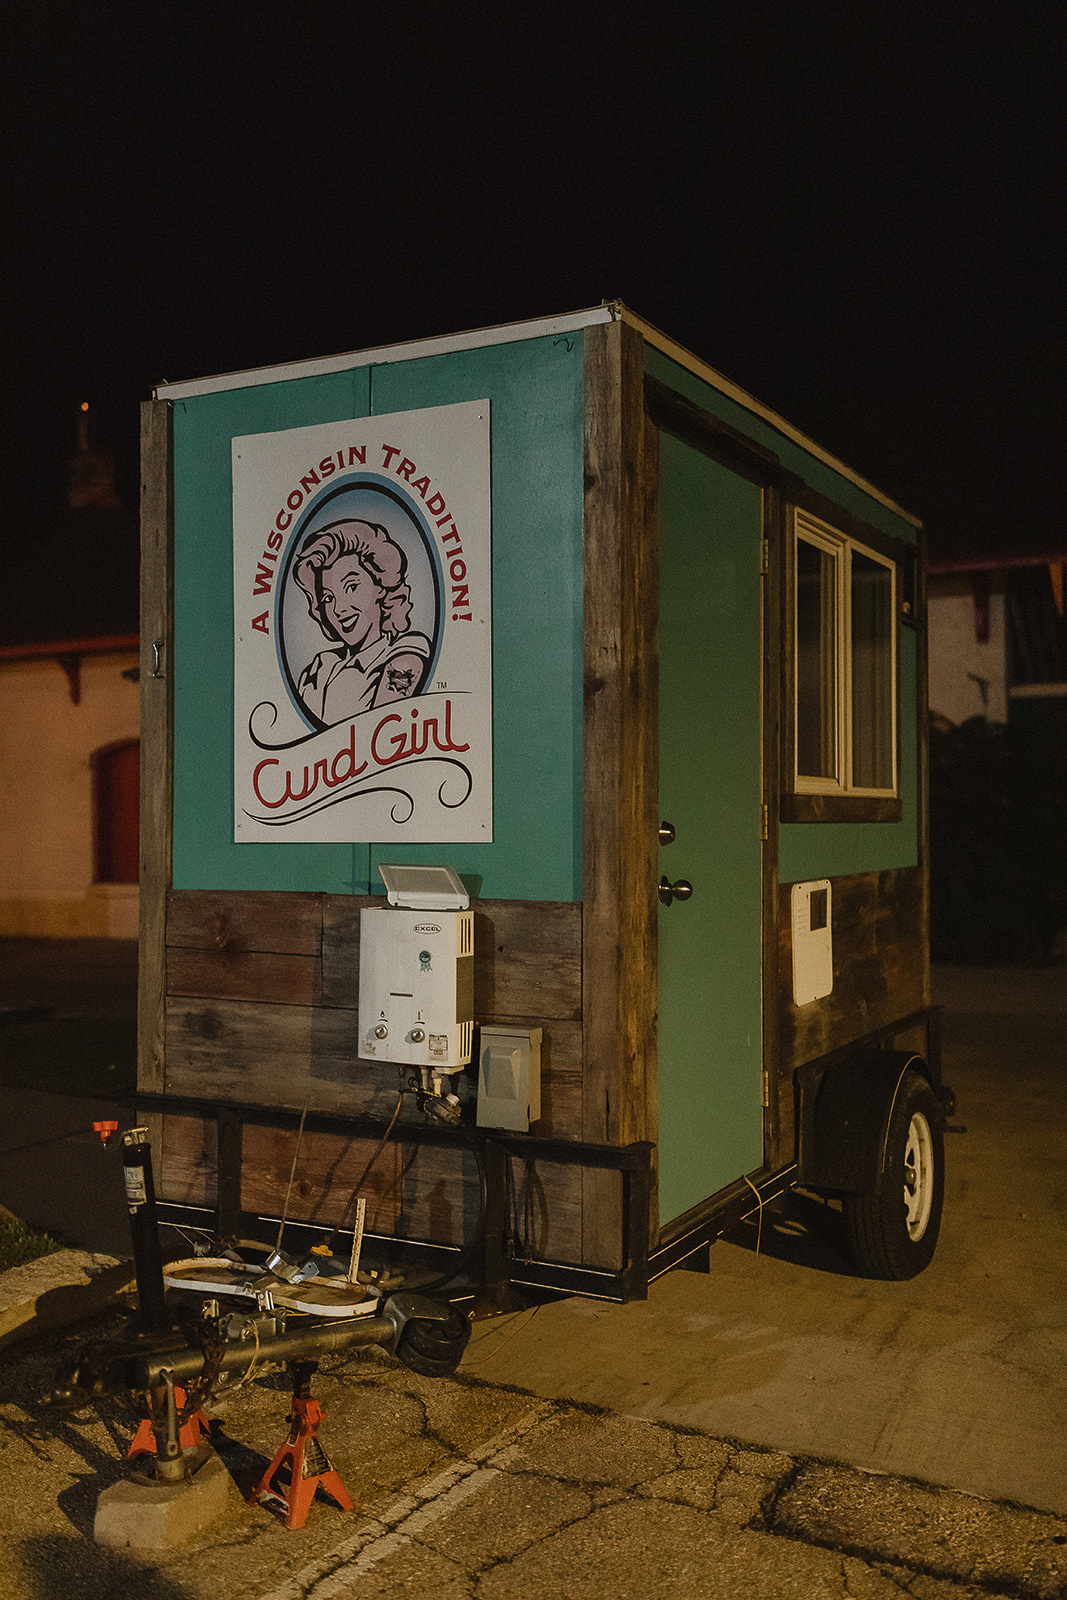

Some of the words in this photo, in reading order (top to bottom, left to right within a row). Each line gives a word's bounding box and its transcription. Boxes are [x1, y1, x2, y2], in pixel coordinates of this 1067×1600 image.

[252, 445, 368, 597] WISCONSIN
[381, 443, 473, 622] TRADITION!
[251, 610, 270, 635] A
[436, 681, 448, 689] TM
[252, 724, 369, 809] Curd
[370, 699, 471, 766] Girl
